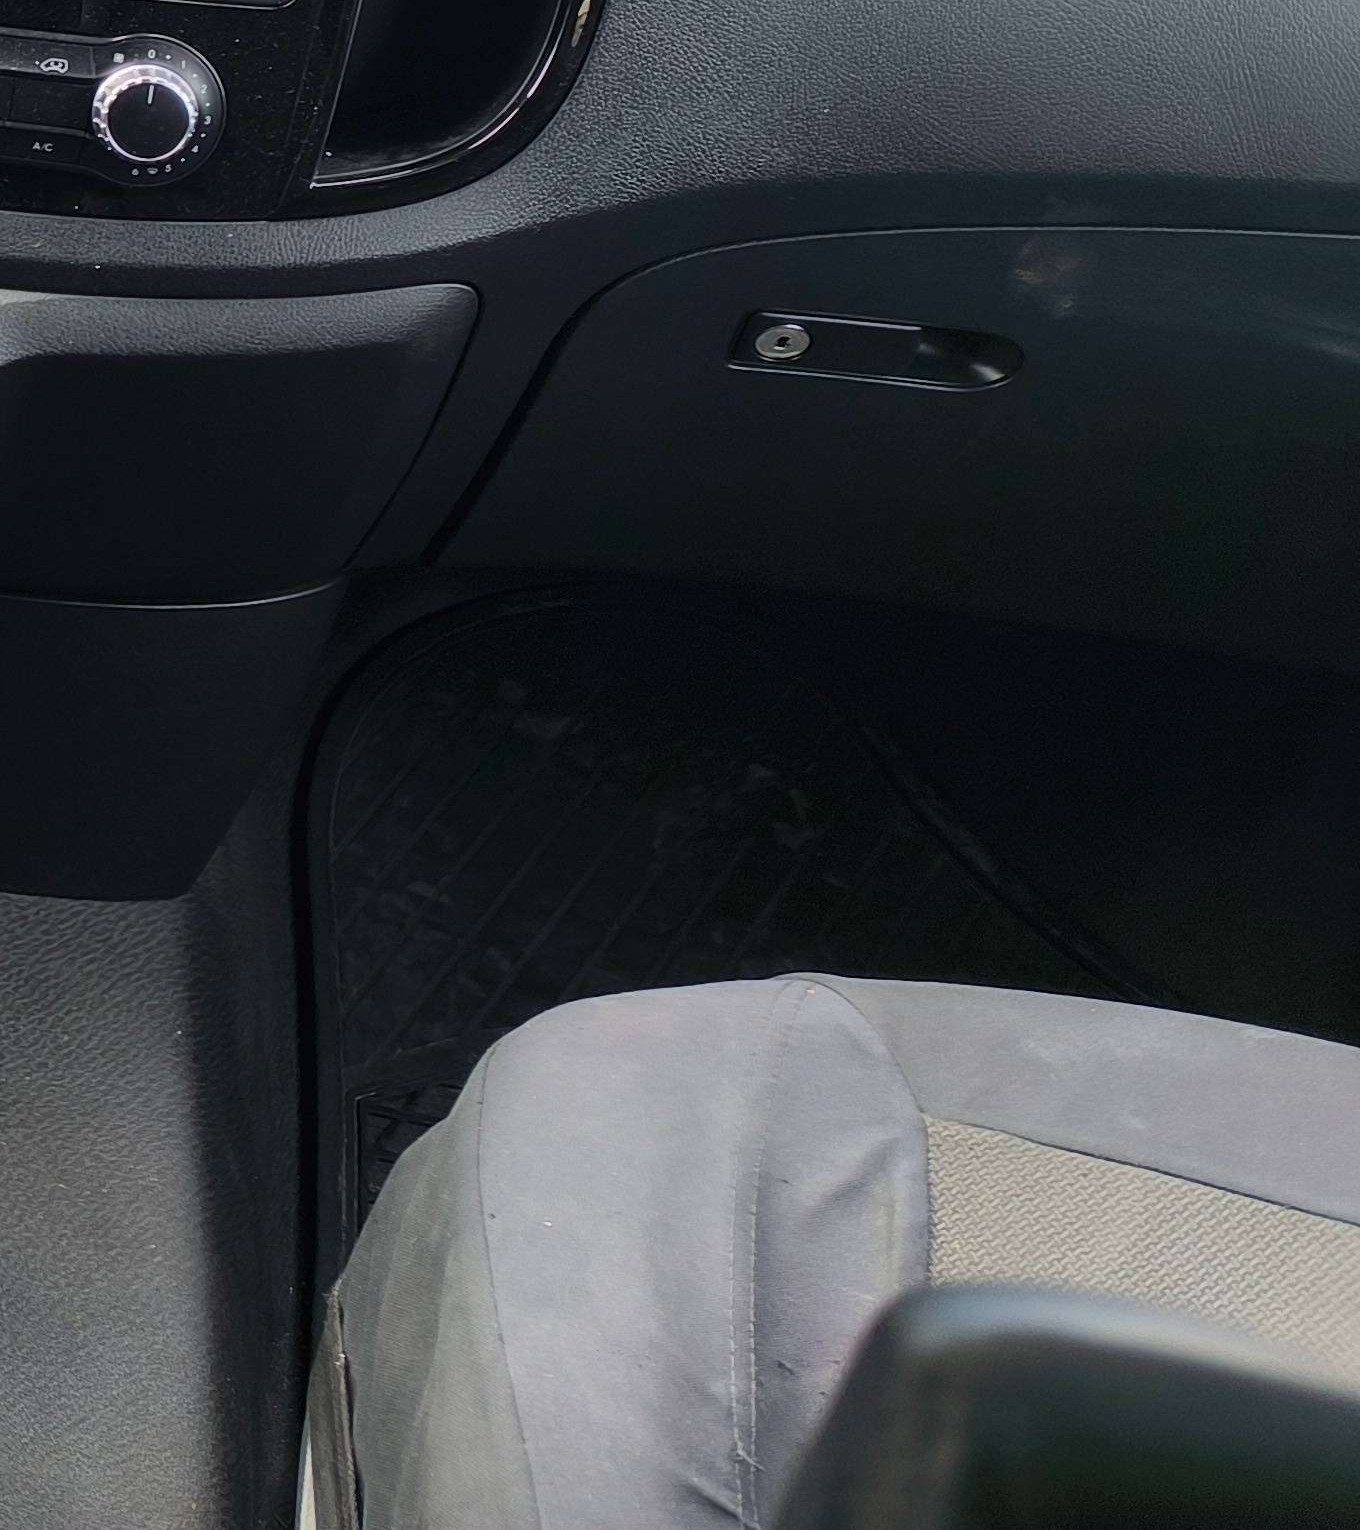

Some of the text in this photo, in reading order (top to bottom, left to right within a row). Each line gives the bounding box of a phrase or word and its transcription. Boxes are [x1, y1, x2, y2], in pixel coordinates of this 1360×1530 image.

[147, 49, 156, 59] 0
[200, 85, 208, 94] 2
[204, 115, 211, 125] 3
[32, 141, 54, 152] A/C
[191, 145, 199, 153] 4
[165, 164, 172, 173] 5
